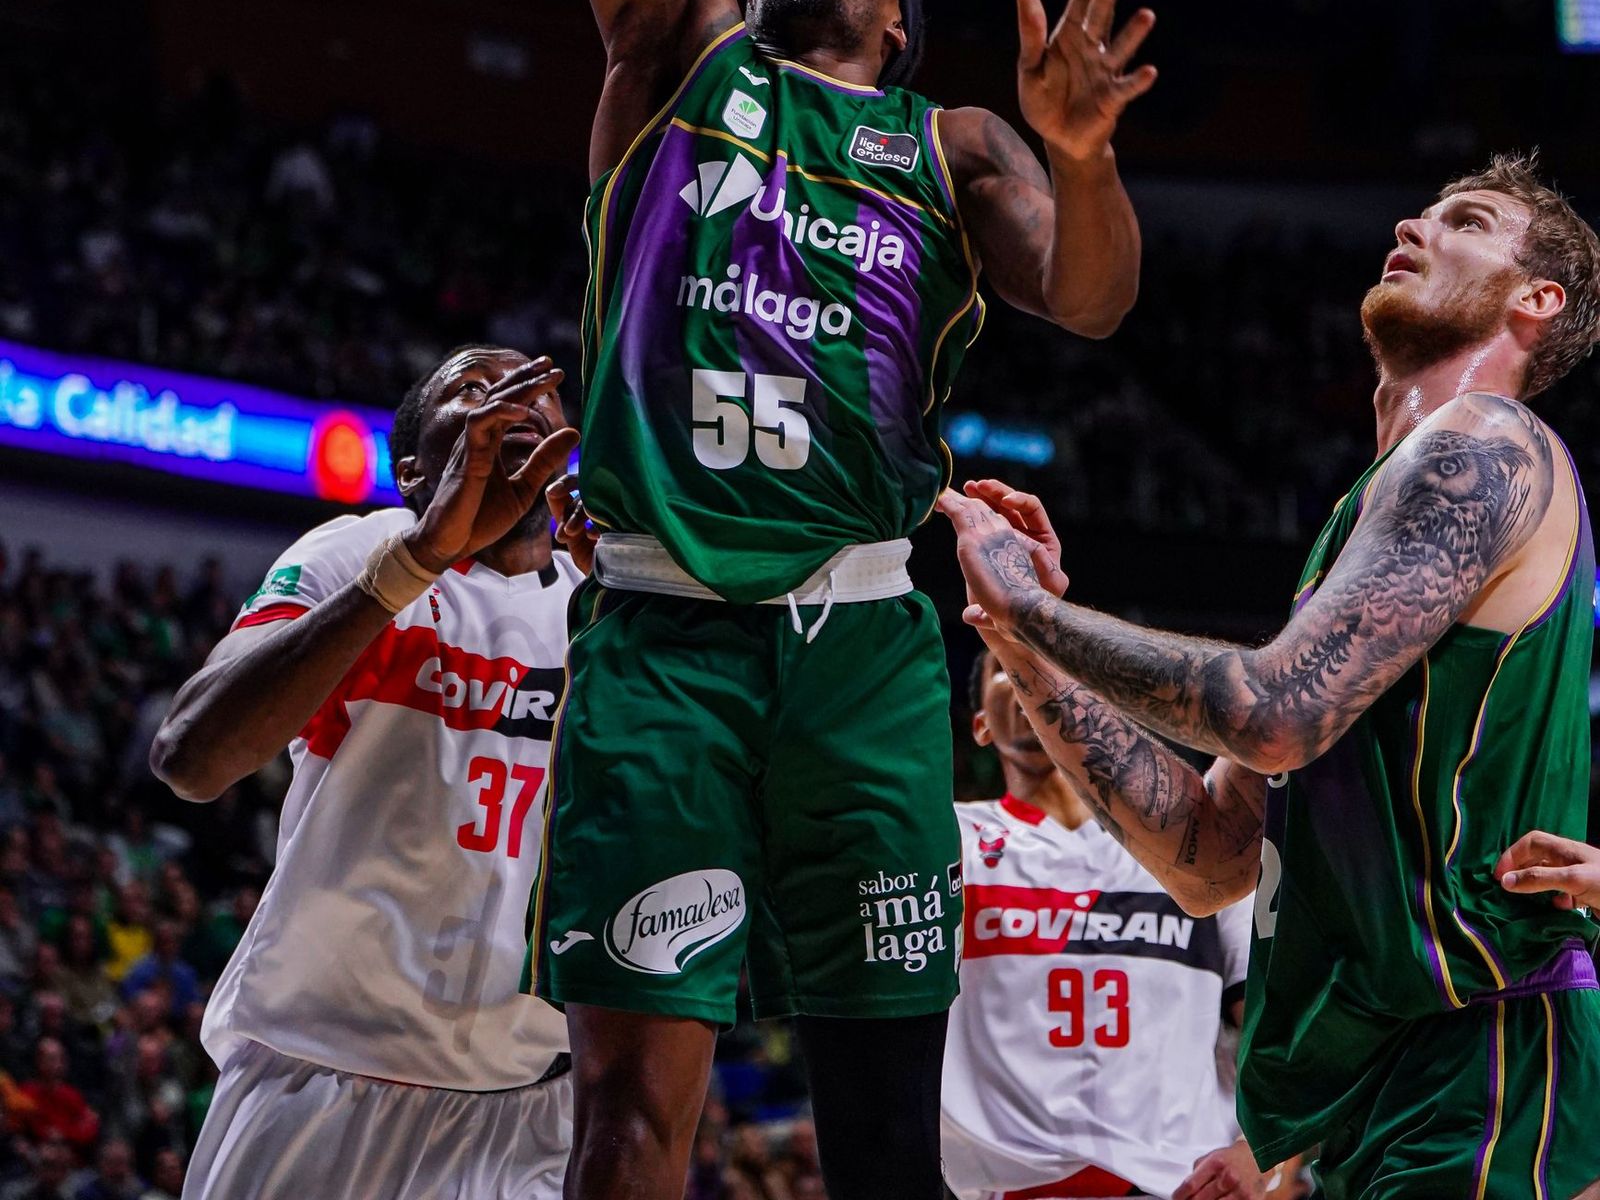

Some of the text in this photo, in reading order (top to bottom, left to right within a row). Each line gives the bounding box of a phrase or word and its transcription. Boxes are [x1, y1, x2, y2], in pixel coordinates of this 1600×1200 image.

[856, 147, 911, 166] endesa
[859, 137, 884, 152] liga
[750, 185, 905, 272] Unicaja
[692, 368, 811, 471] 55
[457, 755, 545, 859] 37
[859, 870, 918, 895] sabor
[860, 875, 945, 928] a má
[622, 878, 740, 955] famadesa
[863, 922, 946, 972] laga
[1048, 968, 1130, 1048] 93
